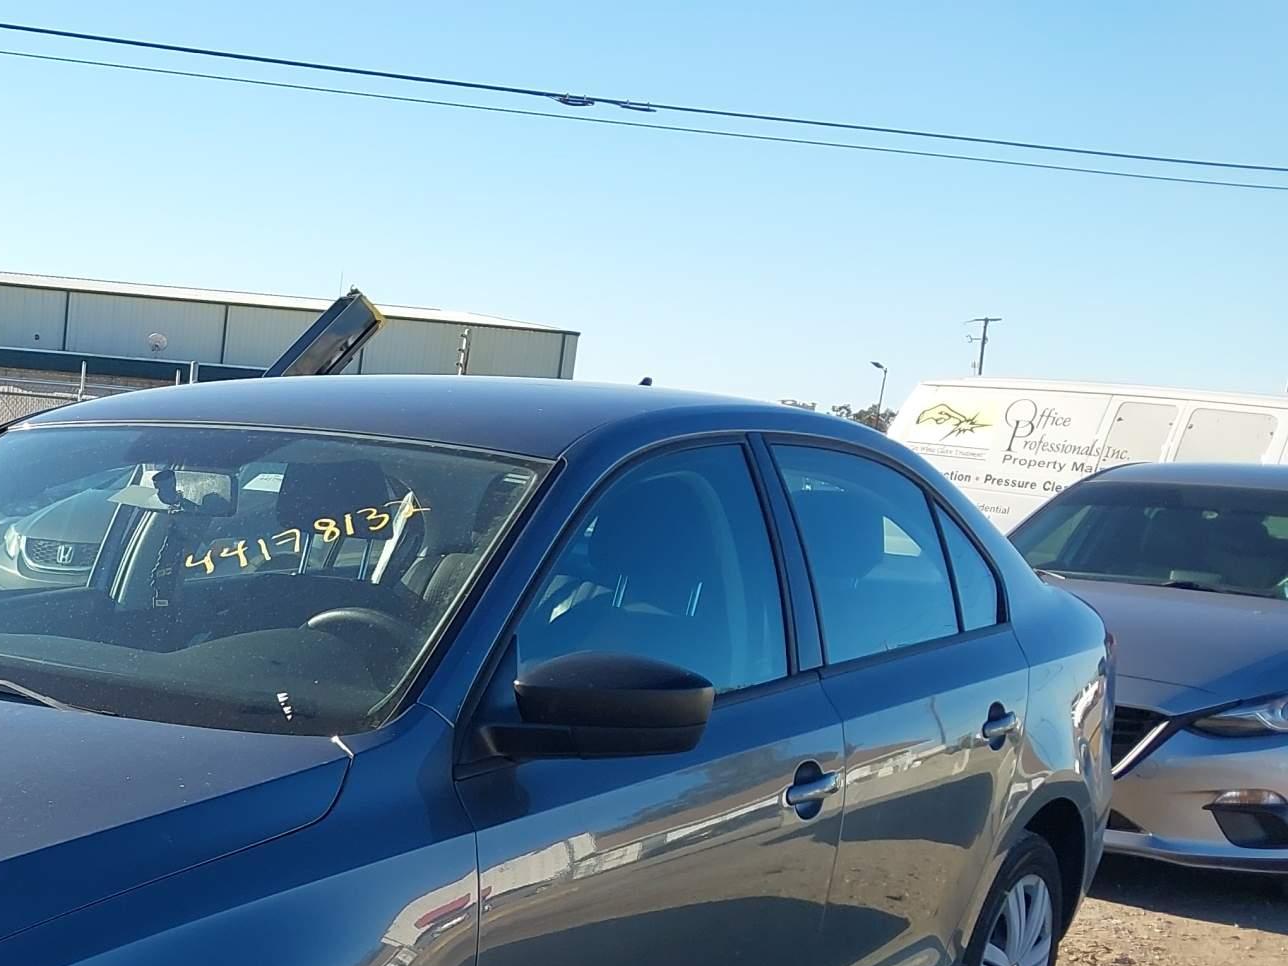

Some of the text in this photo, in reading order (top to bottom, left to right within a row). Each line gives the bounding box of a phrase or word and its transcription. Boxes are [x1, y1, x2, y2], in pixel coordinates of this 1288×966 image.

[1005, 399, 1071, 430] Office
[1001, 420, 1100, 456] Professionals
[1104, 445, 1131, 461] Inc.
[1002, 454, 1105, 474] Property Mai
[984, 474, 1037, 489] Pressure
[977, 502, 1010, 515] dential
